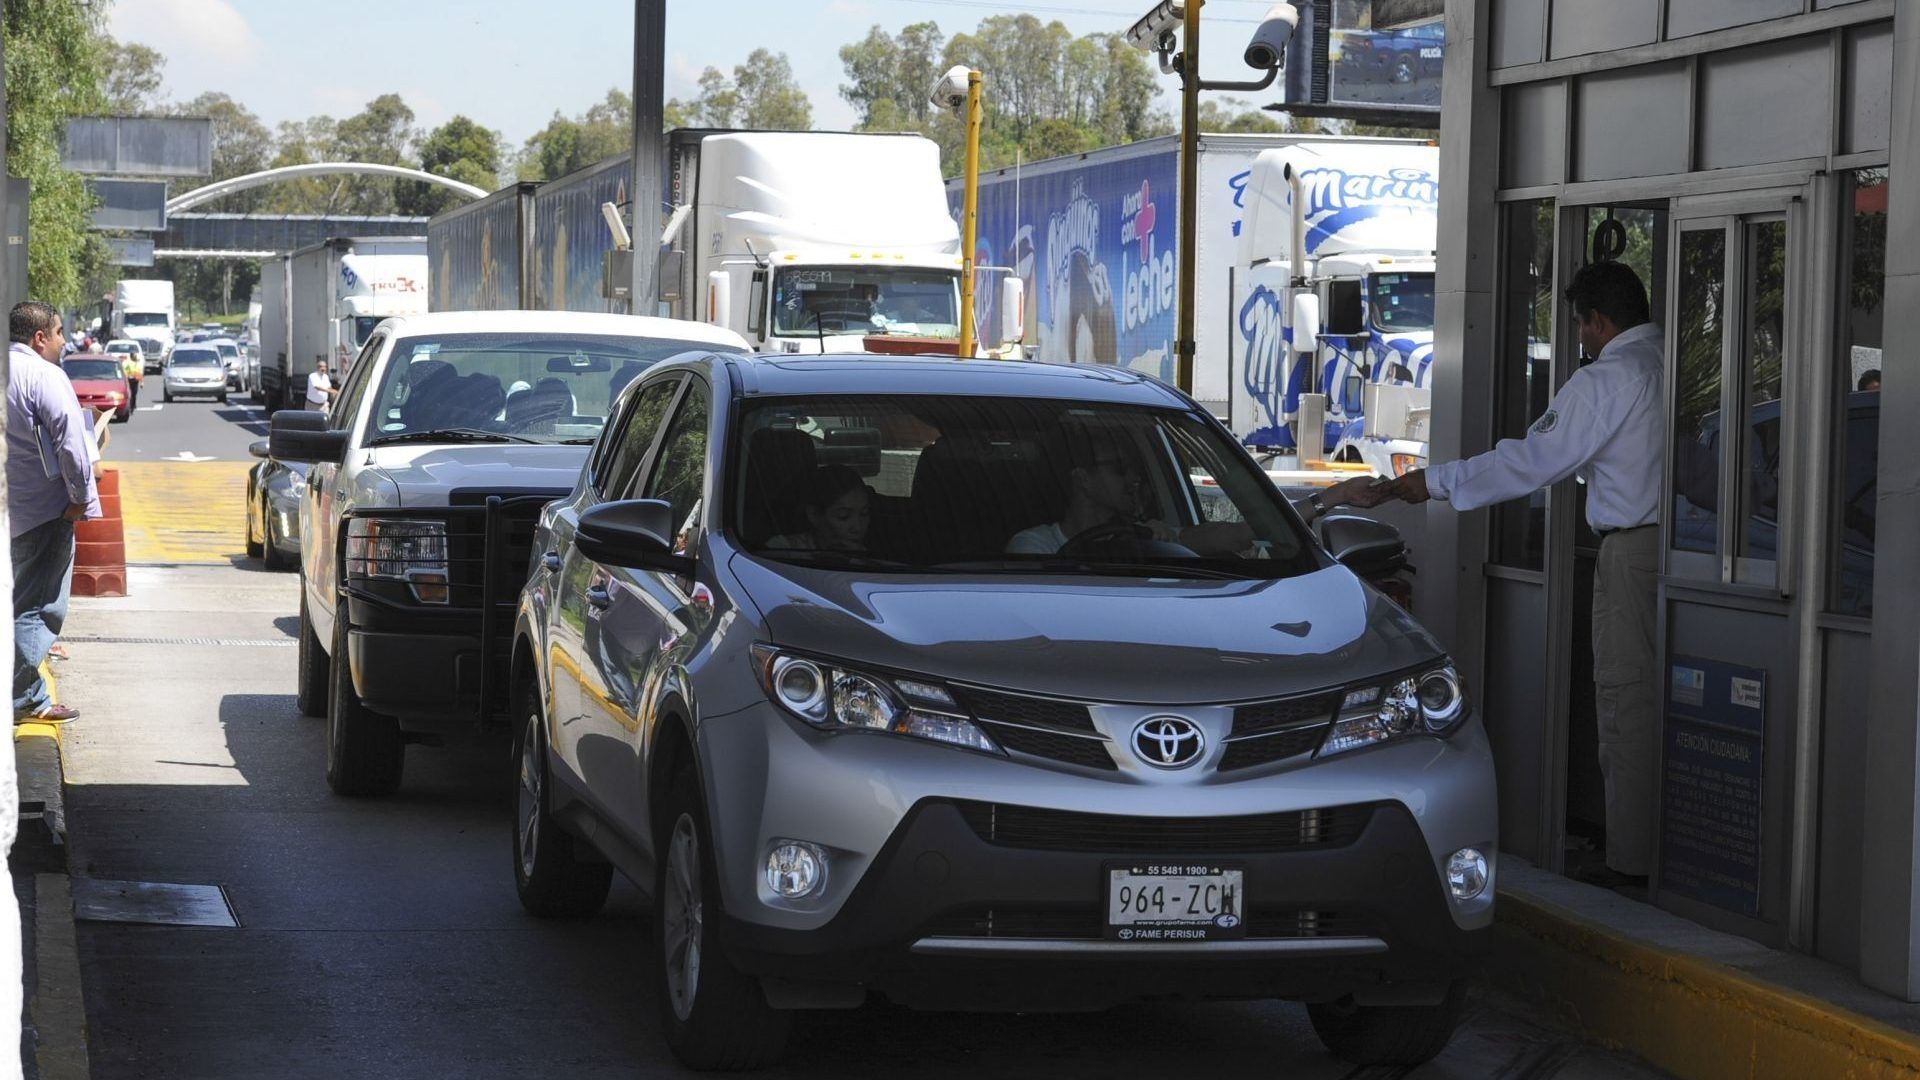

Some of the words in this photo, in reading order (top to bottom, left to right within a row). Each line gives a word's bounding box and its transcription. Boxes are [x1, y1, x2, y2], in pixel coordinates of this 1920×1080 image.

[1298, 168, 1438, 217] Marin
[1121, 234, 1174, 334] leche
[1148, 866, 1159, 875] 55
[1161, 866, 1183, 875] 5481
[1186, 866, 1207, 875] 1900
[1136, 930, 1161, 938] FAME
[1164, 930, 1206, 938] PERISUR
